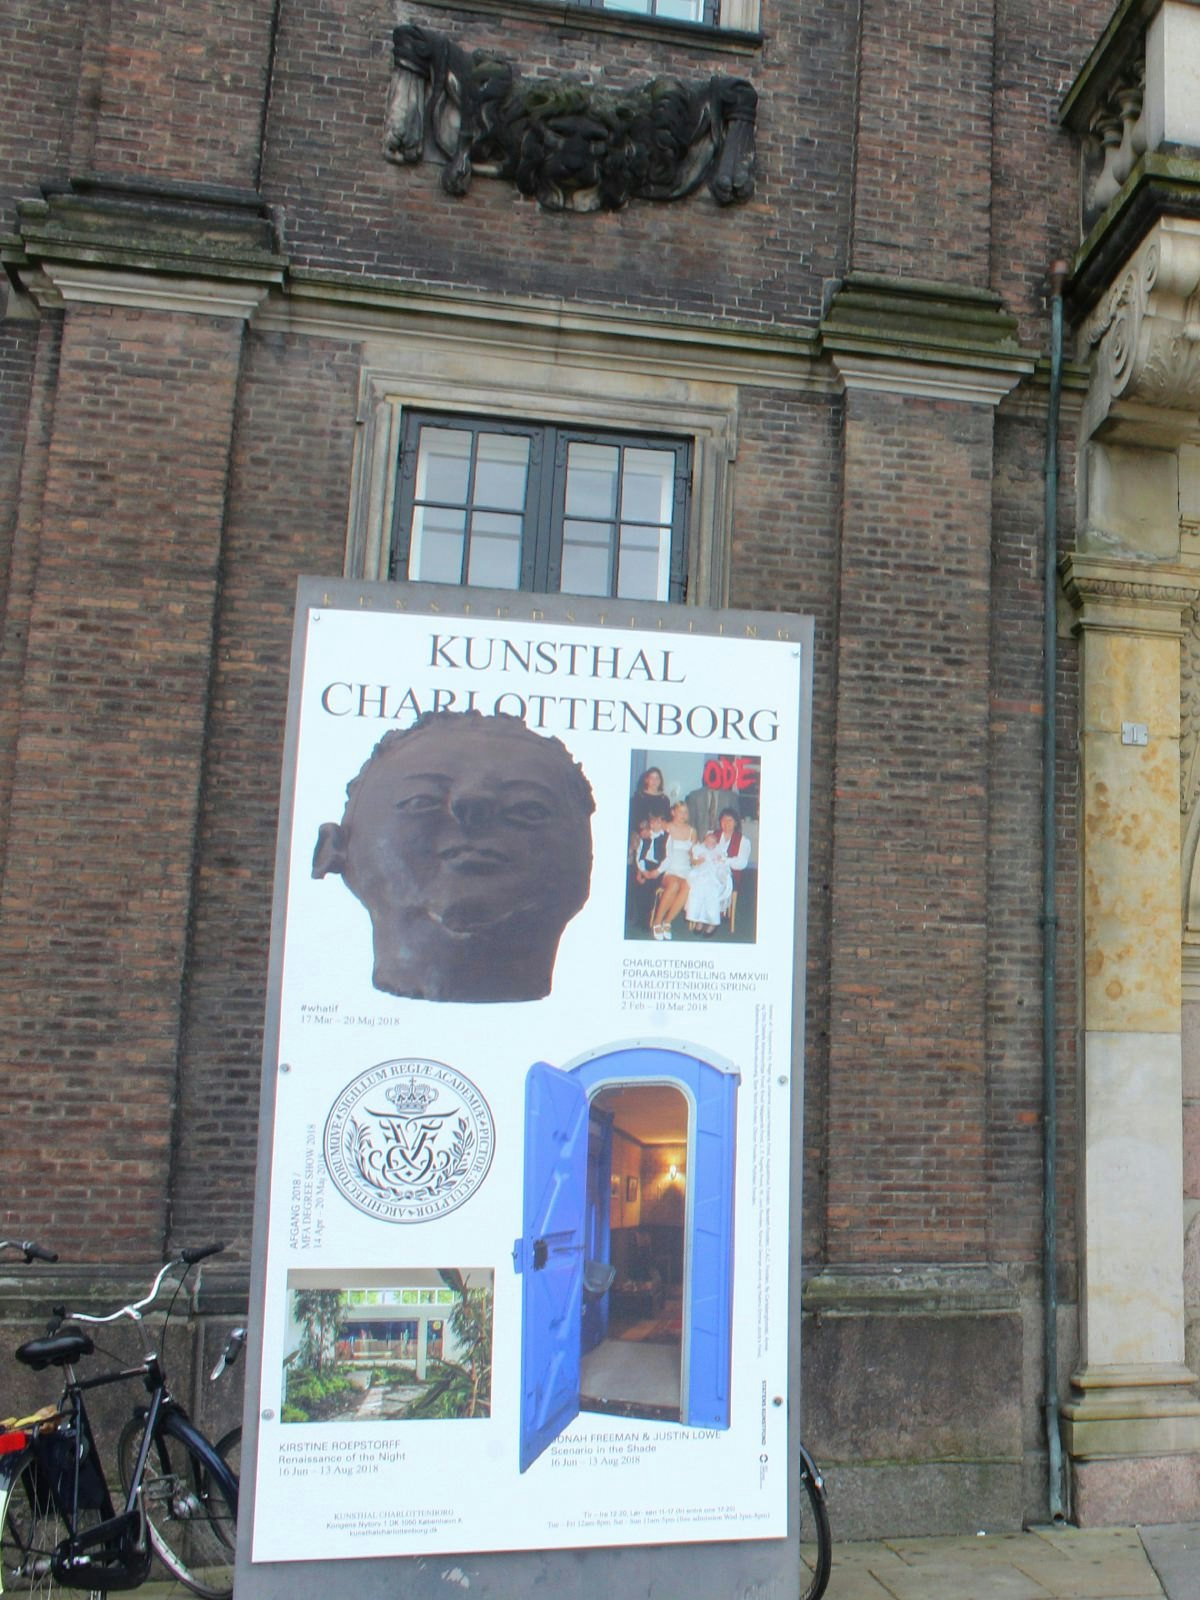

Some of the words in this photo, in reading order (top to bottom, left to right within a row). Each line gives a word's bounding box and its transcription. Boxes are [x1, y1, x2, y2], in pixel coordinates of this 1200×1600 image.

[428, 633, 686, 683] KUNSTHAL
[321, 681, 780, 743] CHARLOTTENBORG
[704, 756, 756, 791] ODE
[622, 958, 714, 969] CHARLOTTENBORG
[622, 968, 726, 980] FORAARSUDSTILLING
[729, 971, 769, 982] MMXVIII
[621, 979, 719, 991] CHARLOTTENBORG
[720, 982, 757, 992] SPRING
[621, 990, 681, 1001] EXHIBITION
[300, 1003, 339, 1013] #whatif
[621, 1001, 627, 1010] 2
[629, 1001, 645, 1011] Feb
[656, 1001, 666, 1011] 10
[667, 1002, 685, 1012] Mar
[687, 1002, 708, 1012] 2018
[301, 1014, 312, 1024] 17
[314, 1015, 332, 1025] Mar
[343, 1015, 355, 1025] 20
[358, 1016, 376, 1027] Maj
[377, 1016, 401, 1026] 2018
[334, 1067, 389, 1116] SIGILLUM
[306, 1124, 316, 1145] 2018
[304, 1148, 315, 1180] SHOW
[317, 1152, 327, 1175] 2018
[291, 1179, 301, 1201] 2018
[316, 1177, 328, 1195] Maj
[302, 1182, 314, 1225] DEGREE
[315, 1198, 325, 1209] 20
[415, 1173, 479, 1220] SCULPTOR
[289, 1205, 301, 1249] AFGANG
[314, 1219, 326, 1237] Apr
[302, 1227, 312, 1249] MFA
[313, 1238, 322, 1249] 14
[591, 1433, 639, 1443] FREEMAN
[642, 1432, 650, 1441] &
[653, 1430, 690, 1441] JUSTIN
[692, 1430, 721, 1440] LOWE
[279, 1441, 328, 1452] KIRSTINE
[331, 1439, 401, 1450] ROEPSTORFF
[551, 1445, 593, 1456] Scenario
[596, 1445, 606, 1454] in
[608, 1444, 623, 1454] the
[626, 1443, 657, 1453] Shade
[278, 1454, 342, 1464] Renaissance
[345, 1453, 356, 1462] of
[359, 1452, 375, 1462] the
[378, 1451, 406, 1463] Night
[551, 1458, 560, 1467] 16
[562, 1457, 578, 1467] Jun
[588, 1456, 598, 1466] 13
[600, 1456, 618, 1467] Aug
[621, 1455, 641, 1465] 2018
[279, 1467, 289, 1476] 16
[292, 1467, 309, 1476] Jun
[320, 1465, 331, 1475] 13
[333, 1465, 353, 1476] Aug
[356, 1464, 379, 1474] 2018
